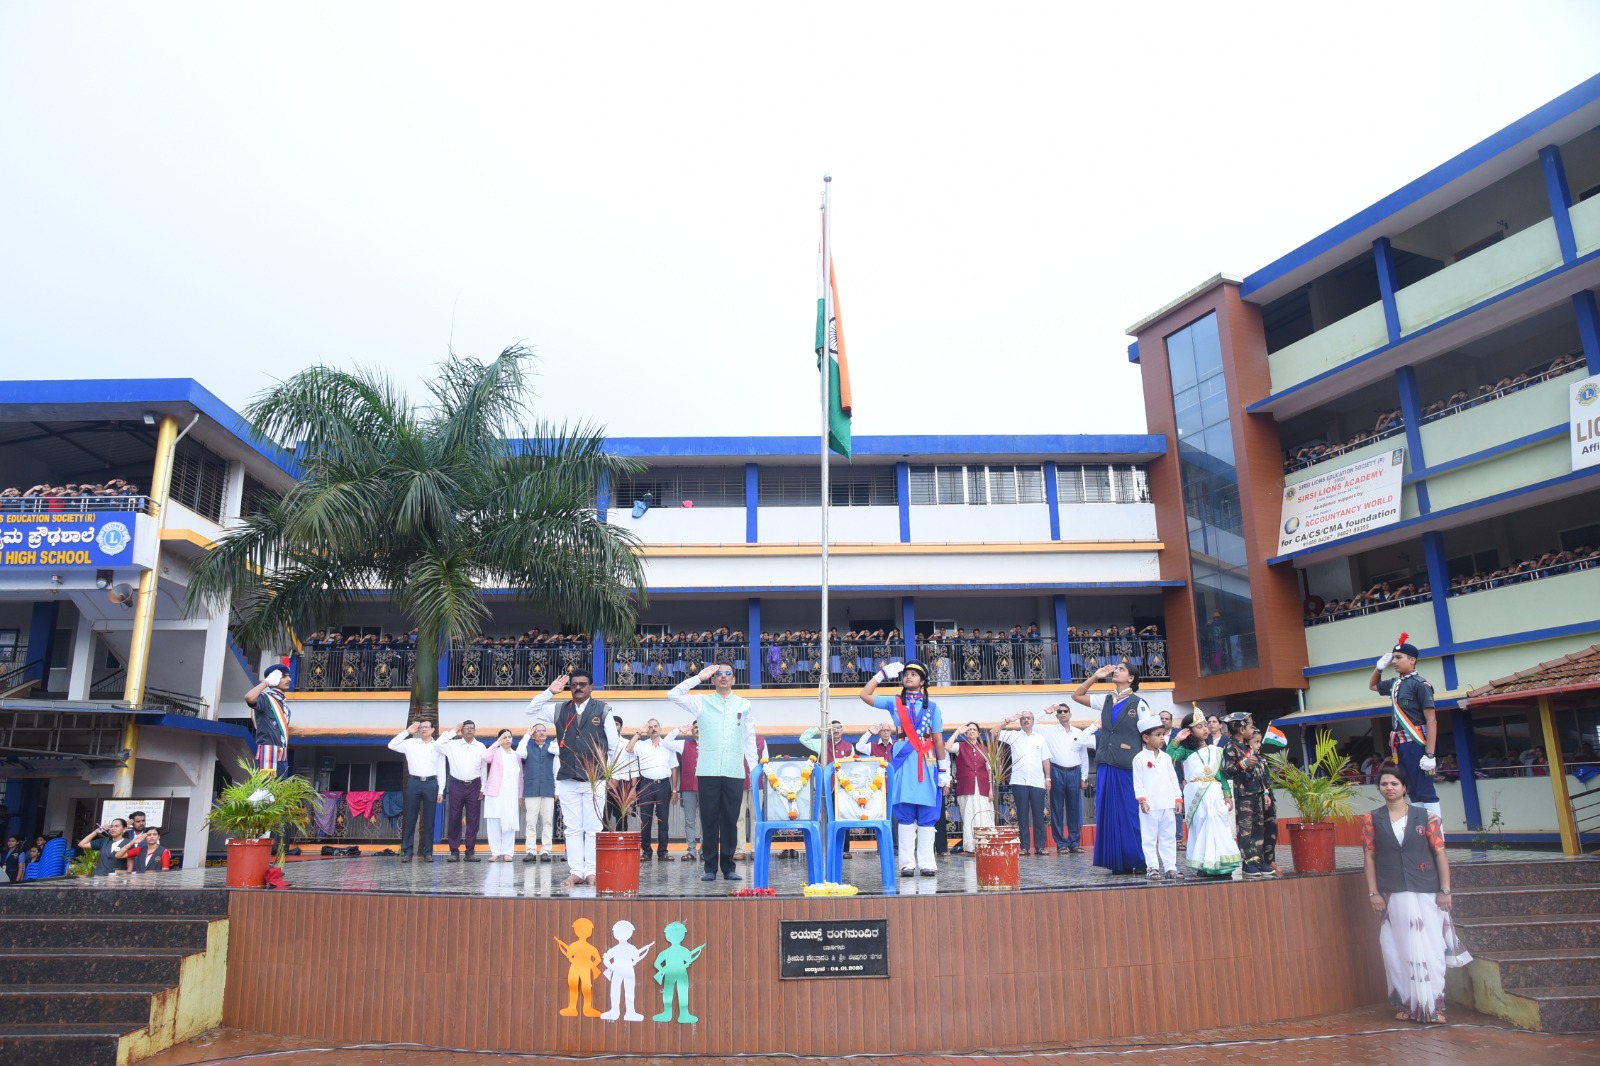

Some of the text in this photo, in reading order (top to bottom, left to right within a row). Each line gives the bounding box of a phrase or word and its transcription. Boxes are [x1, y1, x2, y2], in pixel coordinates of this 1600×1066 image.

[1298, 482, 1310, 490] SIRSI
[1311, 477, 1326, 486] LIONS
[1327, 469, 1354, 482] EDUCATION
[1354, 462, 1376, 471] SOCIETY
[1298, 469, 1384, 503] SIRSI LIONS ACADEMY
[6, 514, 50, 522] EDUCATION
[52, 514, 84, 522] SOCIETY
[1305, 495, 1393, 528] ACCOUNTANCY WORLD
[28, 526, 95, 549] ಪ್ರೌಢಶಾಲೆ
[1281, 507, 1396, 547] for CA/CS/CMA foundation
[5, 550, 36, 565] HIGH
[40, 550, 92, 565] SCHOOL
[826, 928, 879, 938] ರಂಗಮಂದಿರ
